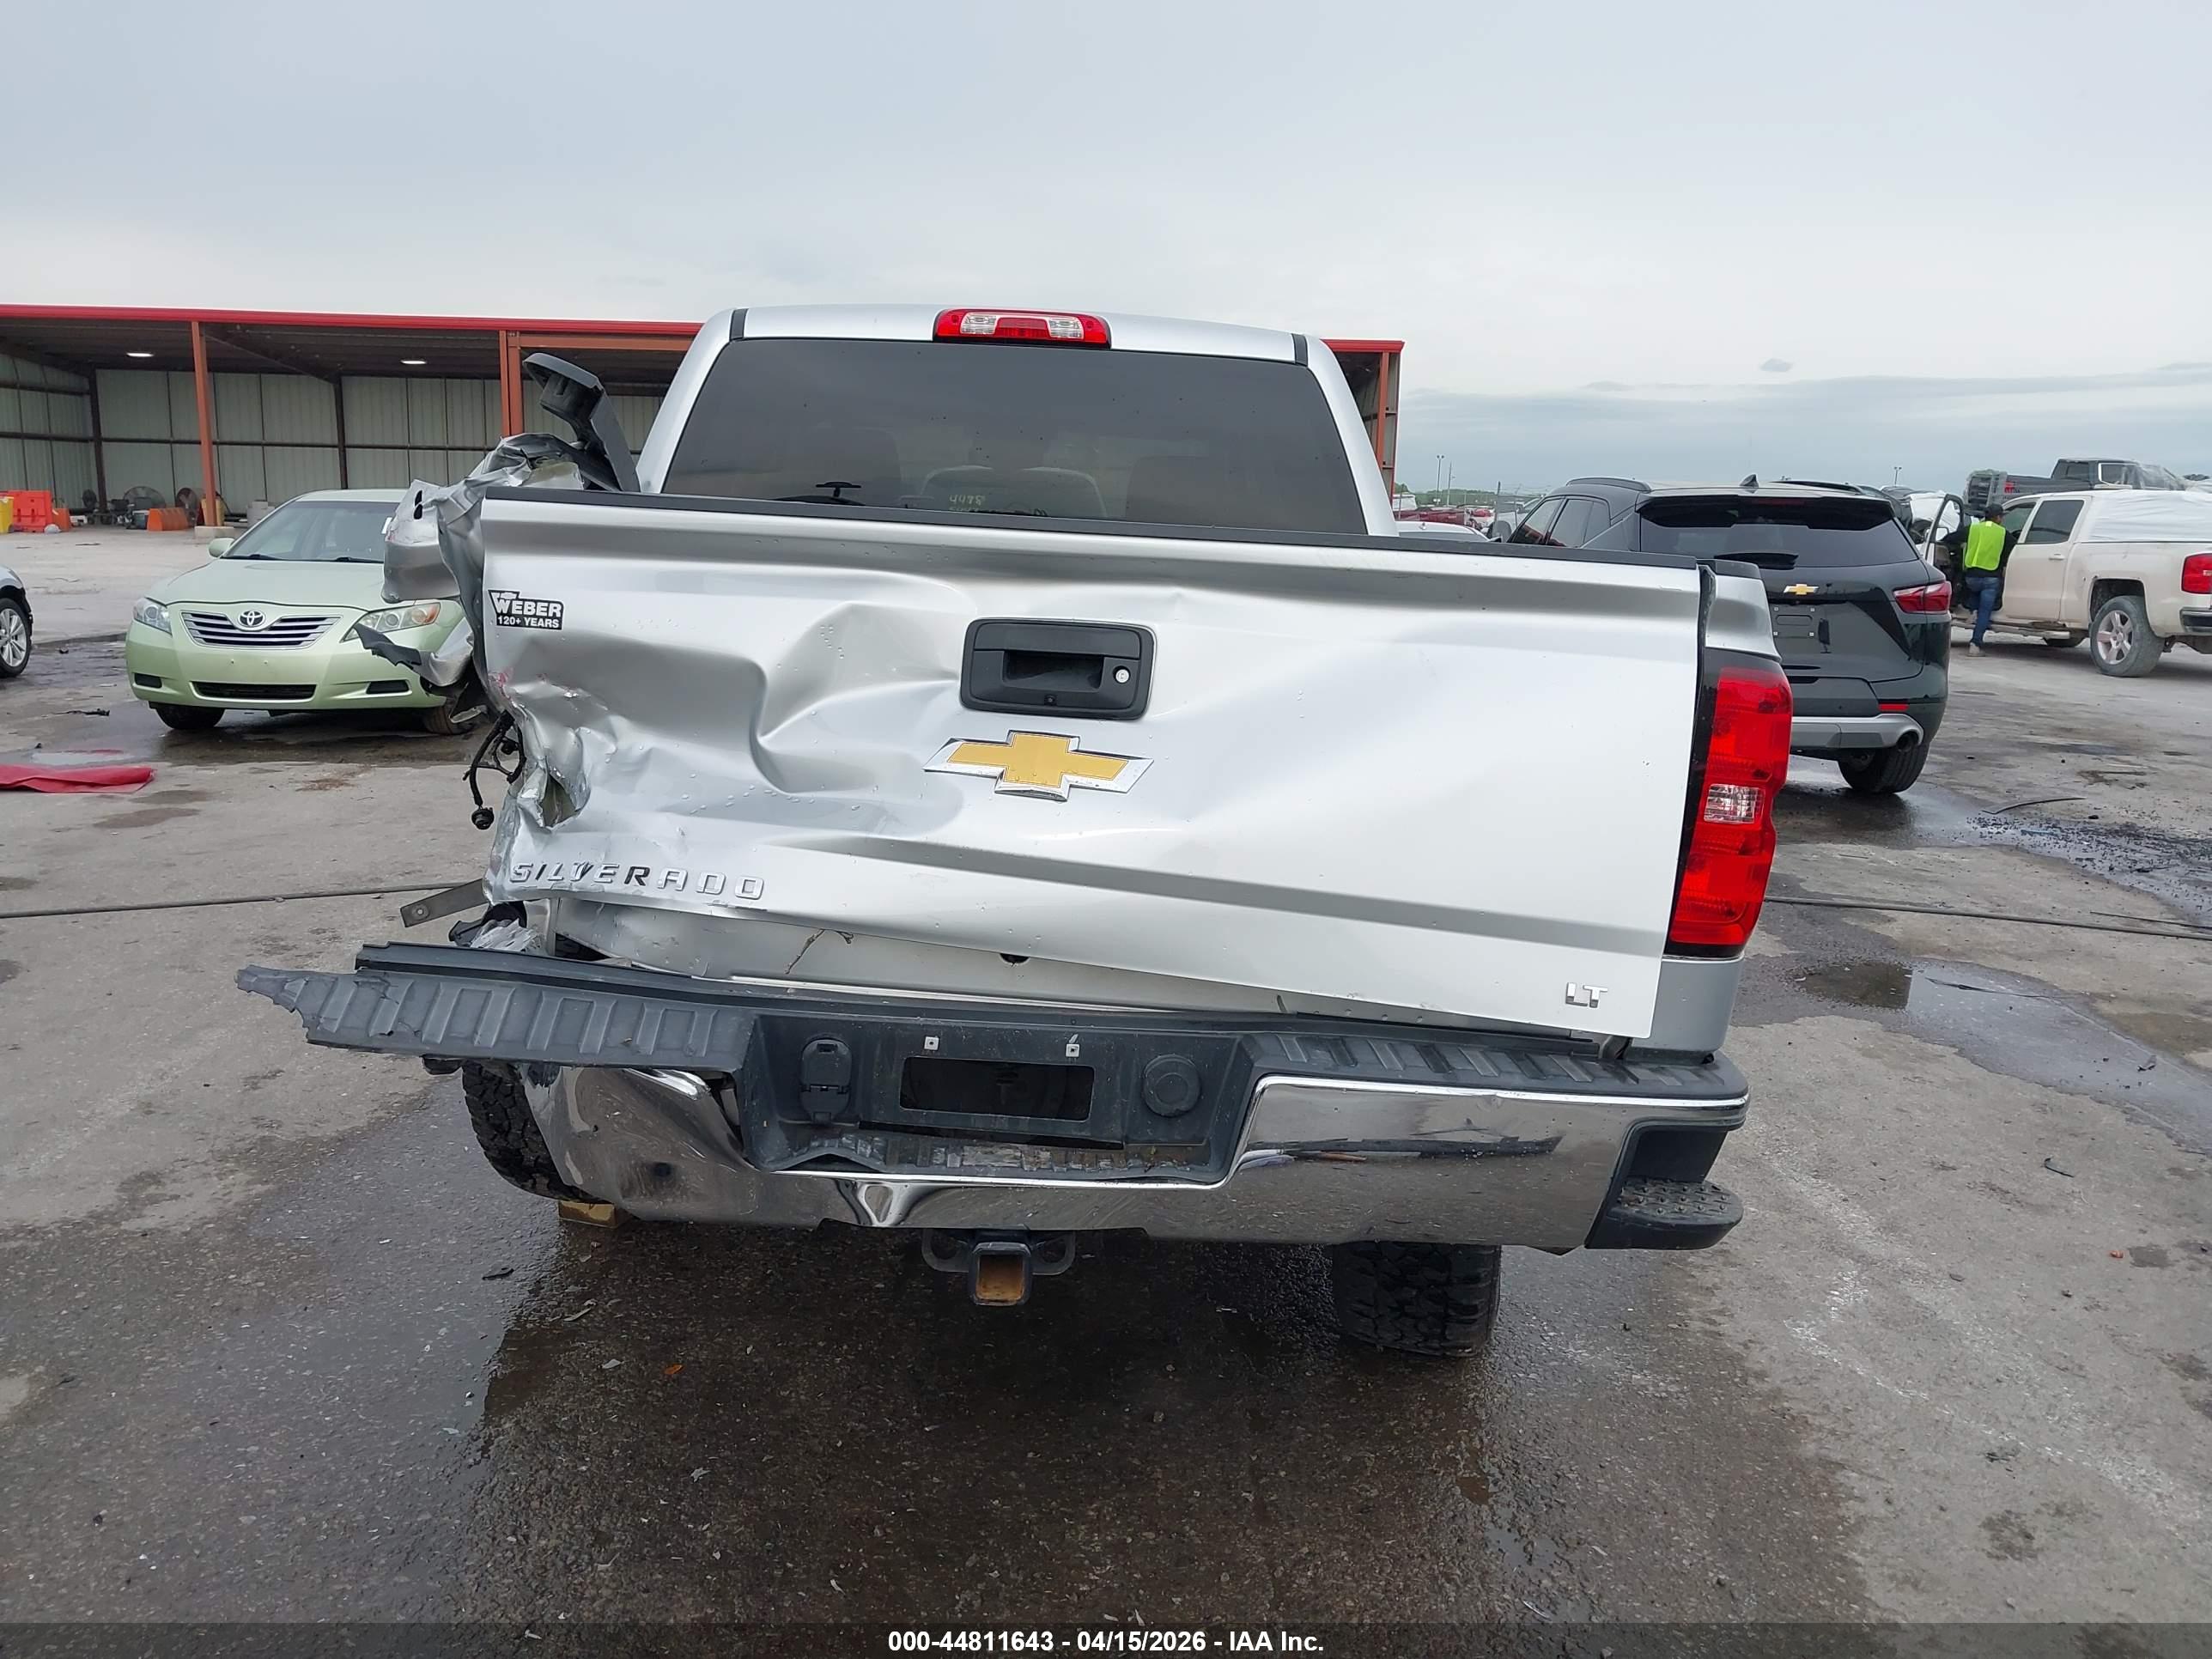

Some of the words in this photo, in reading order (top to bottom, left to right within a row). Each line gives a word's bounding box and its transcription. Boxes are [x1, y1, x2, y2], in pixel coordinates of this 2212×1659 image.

[490, 592, 562, 617] WEBER
[498, 616, 521, 625] 120+
[524, 617, 560, 629] YEARS
[509, 861, 764, 900] SILVERADO
[1565, 981, 1608, 1008] LT
